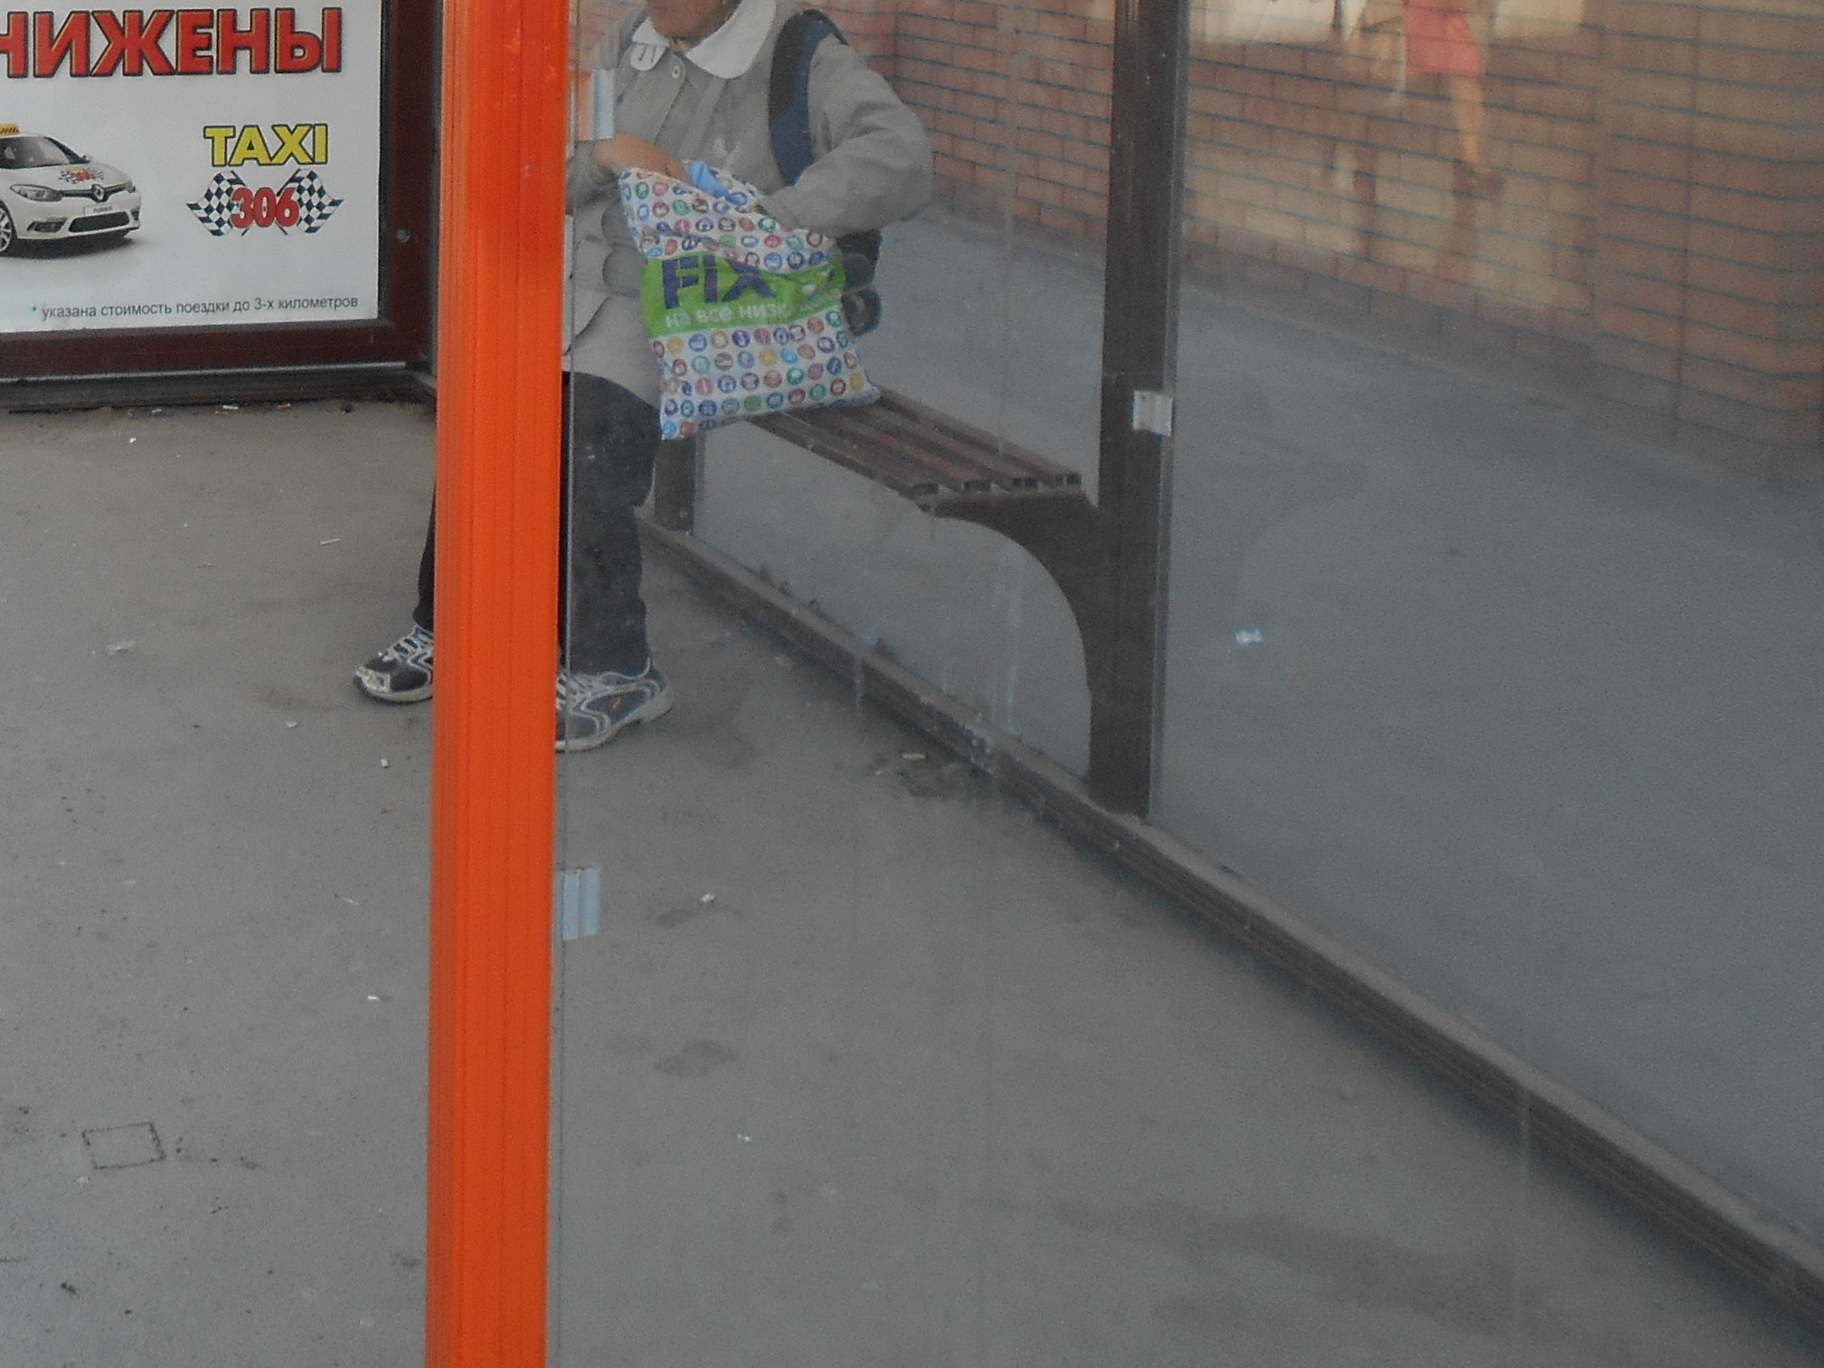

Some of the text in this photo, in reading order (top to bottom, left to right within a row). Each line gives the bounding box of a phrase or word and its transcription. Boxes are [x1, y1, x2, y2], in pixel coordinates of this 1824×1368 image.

[203, 123, 328, 167] TAXI
[230, 187, 300, 229] 306
[42, 305, 97, 322] указана
[101, 304, 172, 316] стоимость
[176, 301, 230, 315] поездки
[233, 300, 250, 313] до
[278, 297, 358, 311] километров
